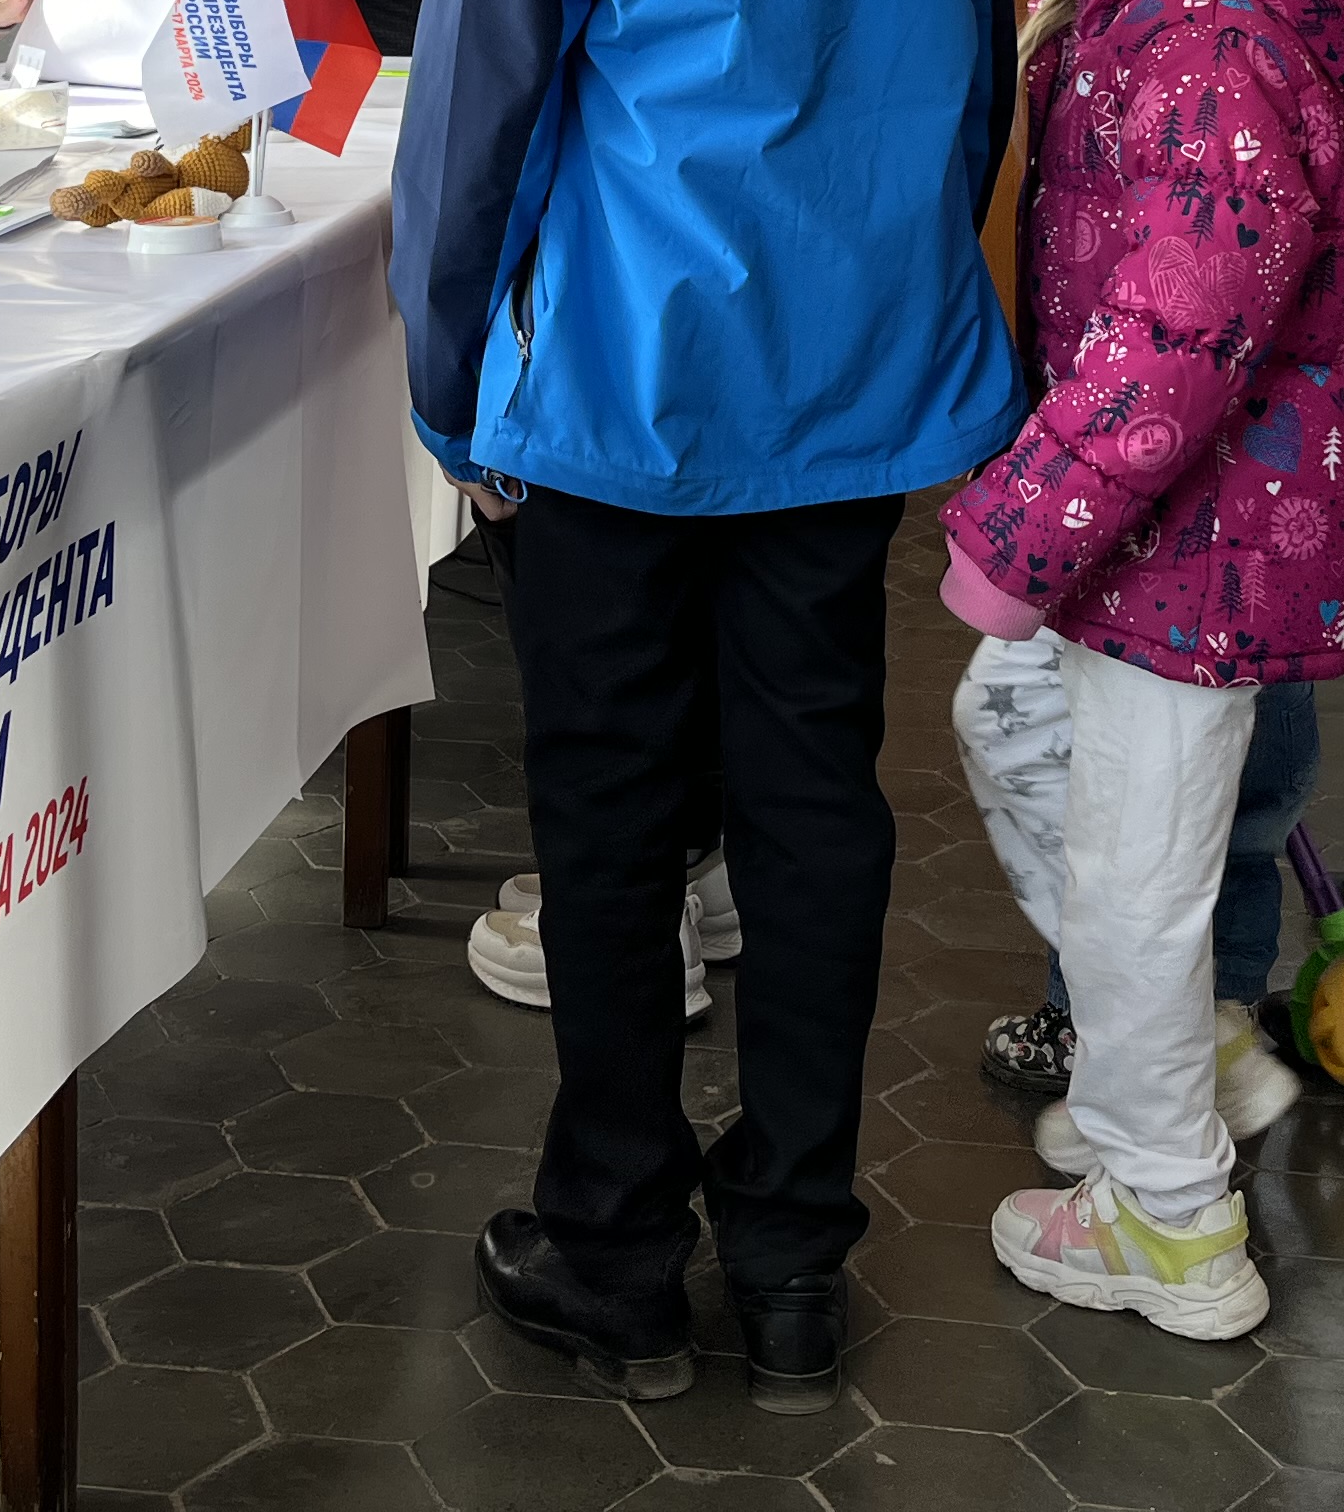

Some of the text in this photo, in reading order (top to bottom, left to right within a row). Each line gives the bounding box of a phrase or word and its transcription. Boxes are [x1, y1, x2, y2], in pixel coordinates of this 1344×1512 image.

[173, 28, 194, 68] МАРТА
[184, 71, 205, 101] 2024
[18, 776, 90, 903] 2024
